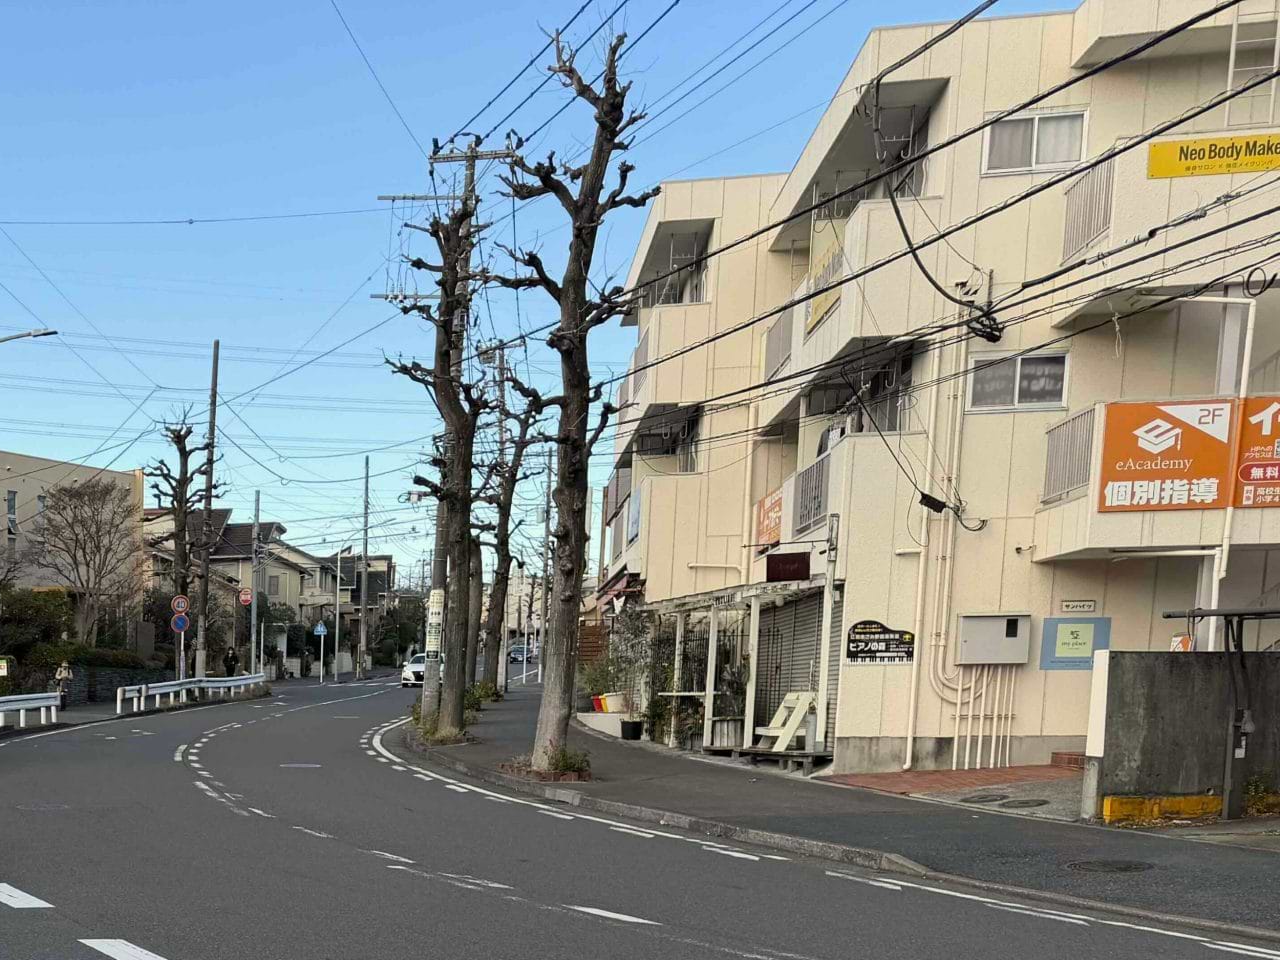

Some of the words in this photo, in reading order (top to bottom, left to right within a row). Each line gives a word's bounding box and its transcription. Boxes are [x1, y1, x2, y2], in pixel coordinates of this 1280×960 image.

[1179, 145, 1206, 161] Neo
[1208, 142, 1243, 160] Body
[1198, 408, 1224, 425] 2F
[1116, 456, 1193, 472] eAcademy
[1104, 478, 1219, 507] 個別指導
